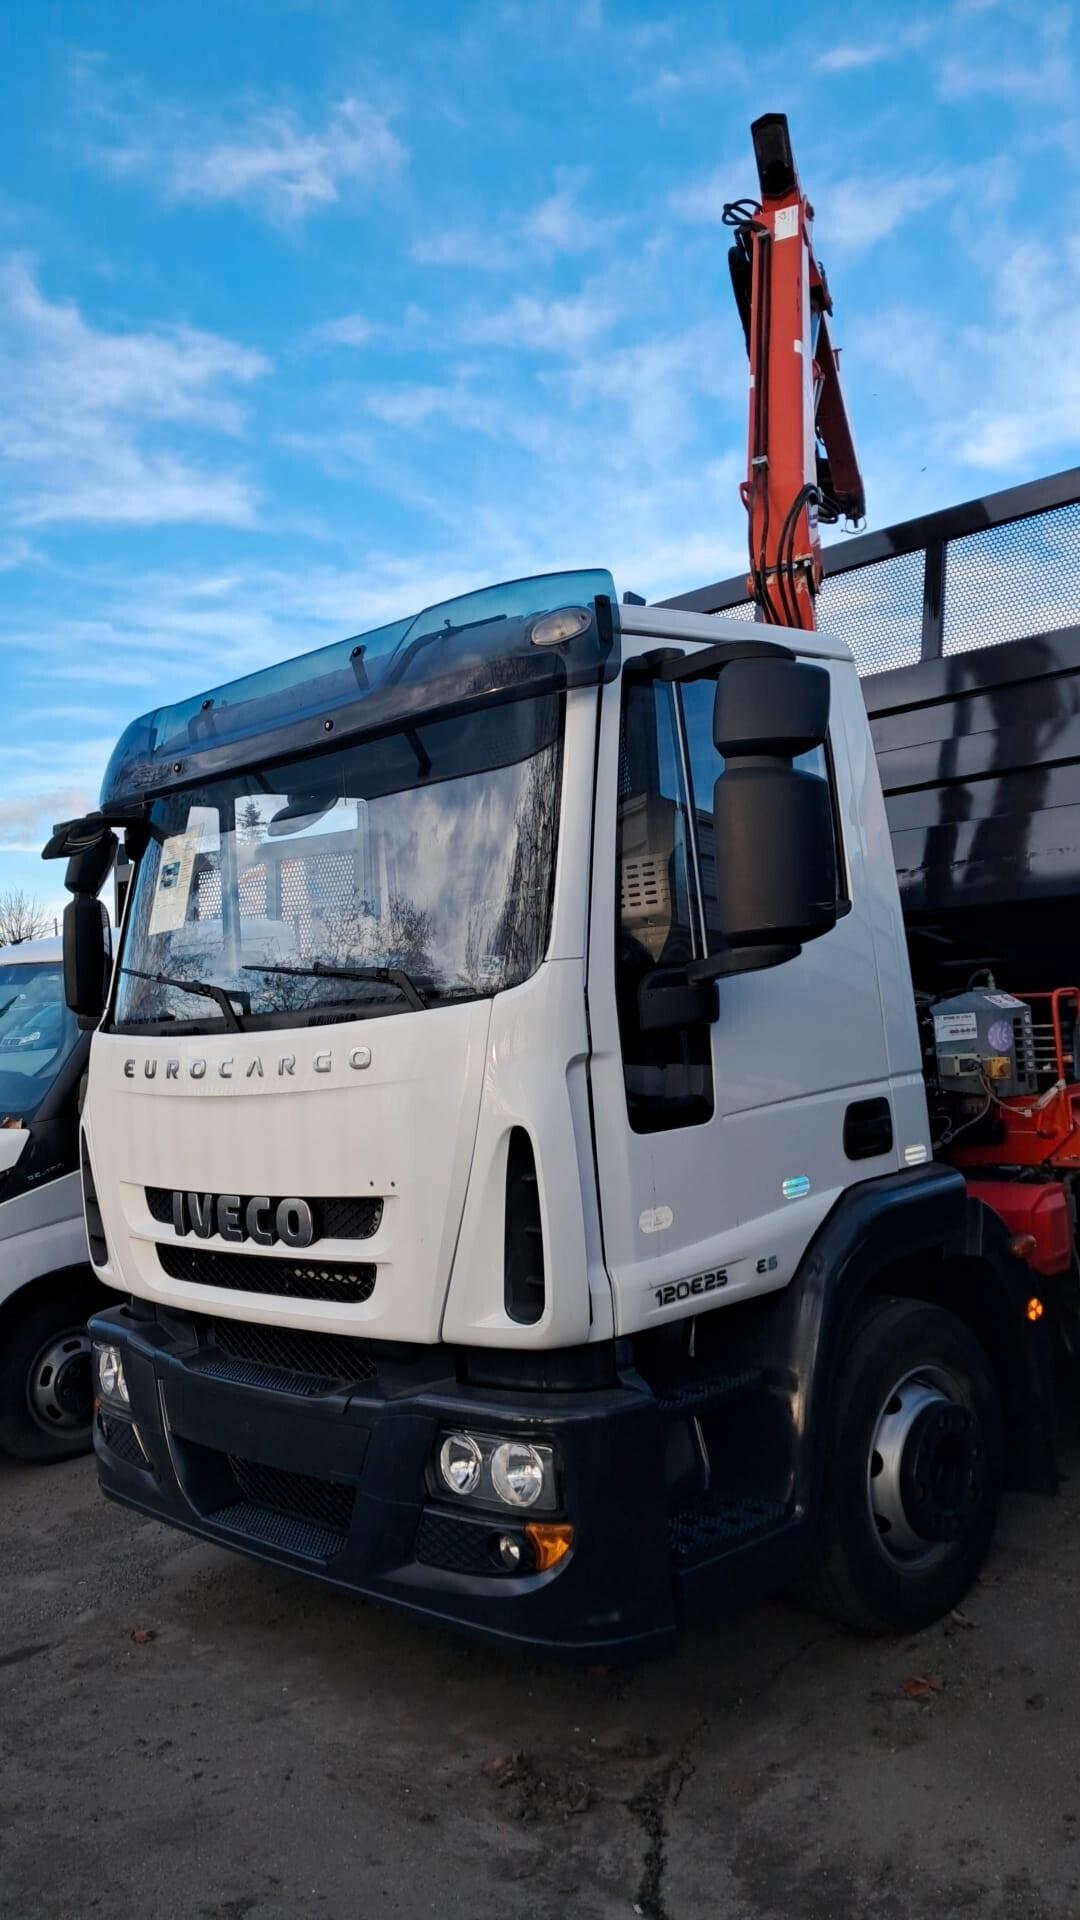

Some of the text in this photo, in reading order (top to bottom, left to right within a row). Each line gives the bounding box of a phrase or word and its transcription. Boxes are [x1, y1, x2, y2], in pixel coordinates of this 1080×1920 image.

[123, 1046, 372, 1079] EUROCARGO
[172, 1191, 314, 1248] IVECO
[656, 1269, 728, 1306] 120E25
